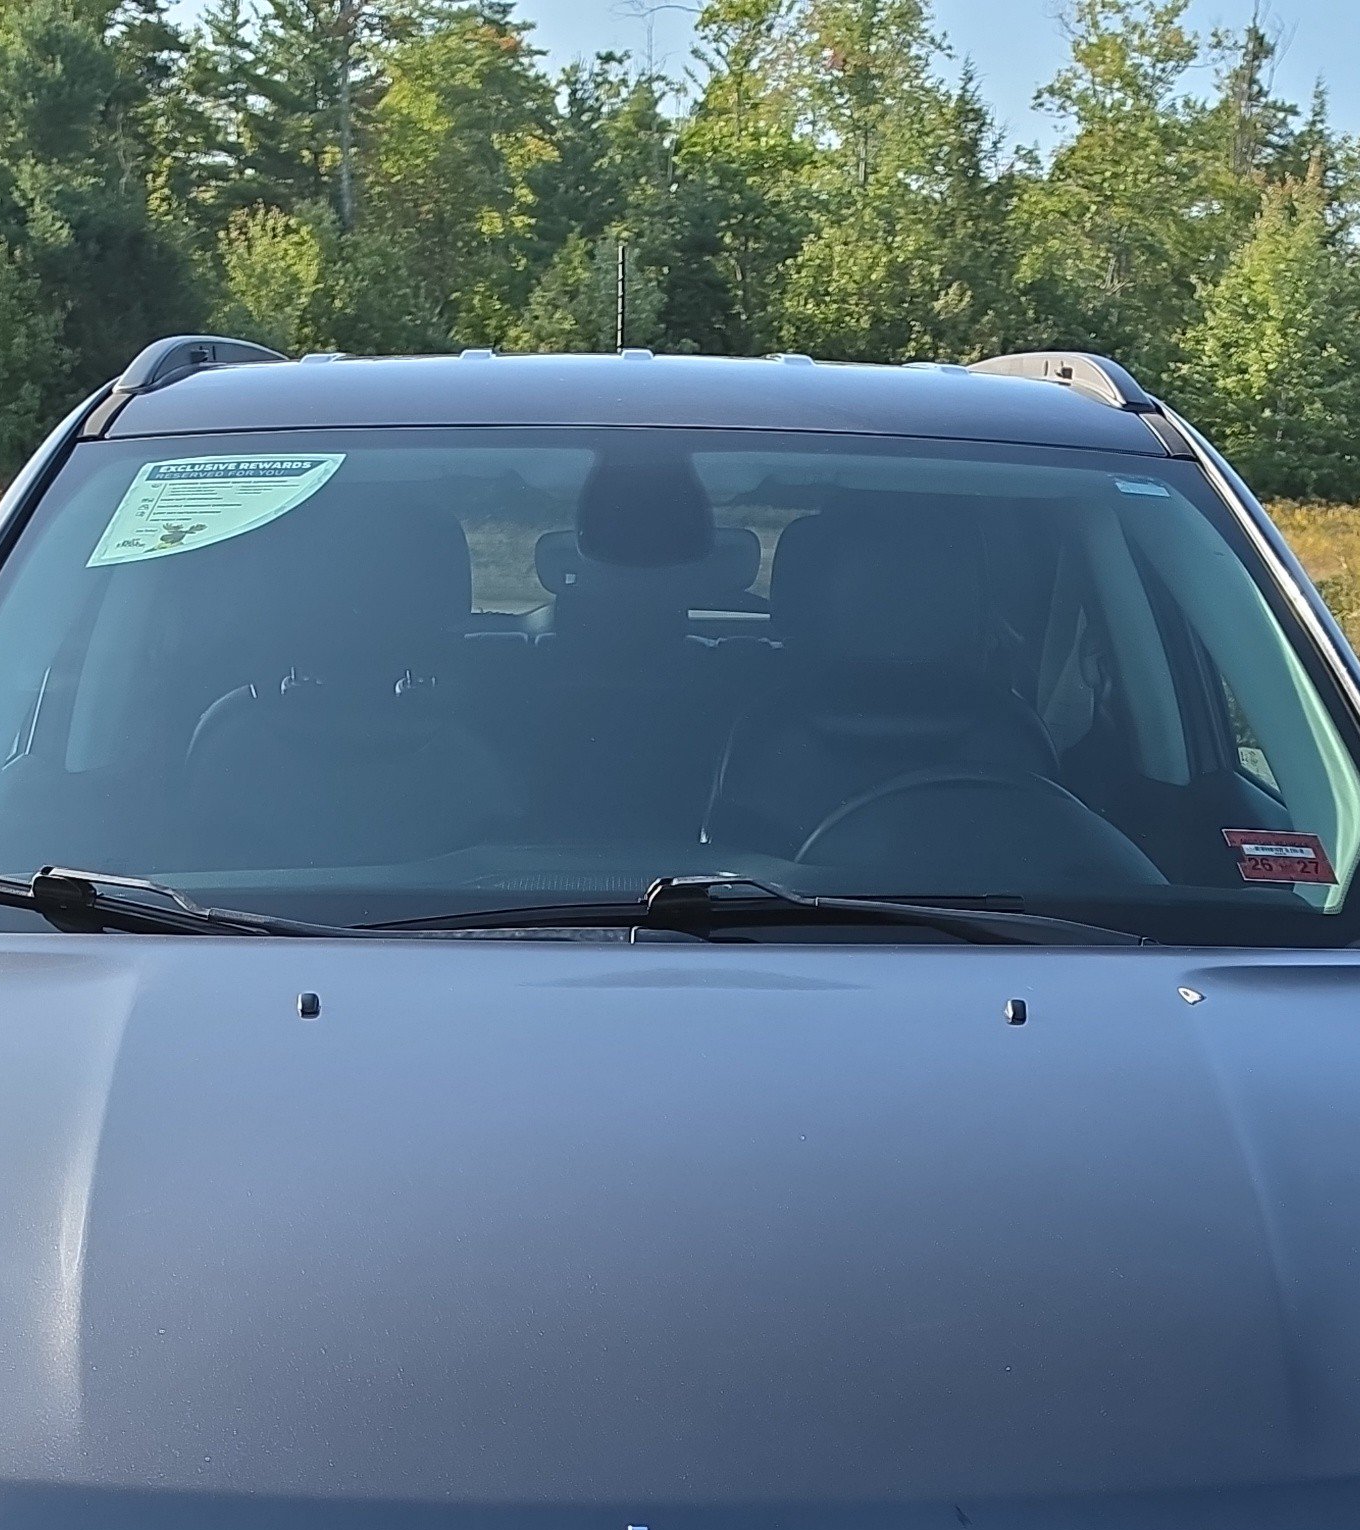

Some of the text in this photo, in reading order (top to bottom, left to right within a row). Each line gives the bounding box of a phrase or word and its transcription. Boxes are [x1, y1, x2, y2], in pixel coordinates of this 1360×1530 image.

[159, 461, 312, 473] EXCLUSIVE REWARDS
[155, 470, 224, 479] RESERVED
[1248, 857, 1274, 872] 26
[1297, 860, 1320, 874] 27
